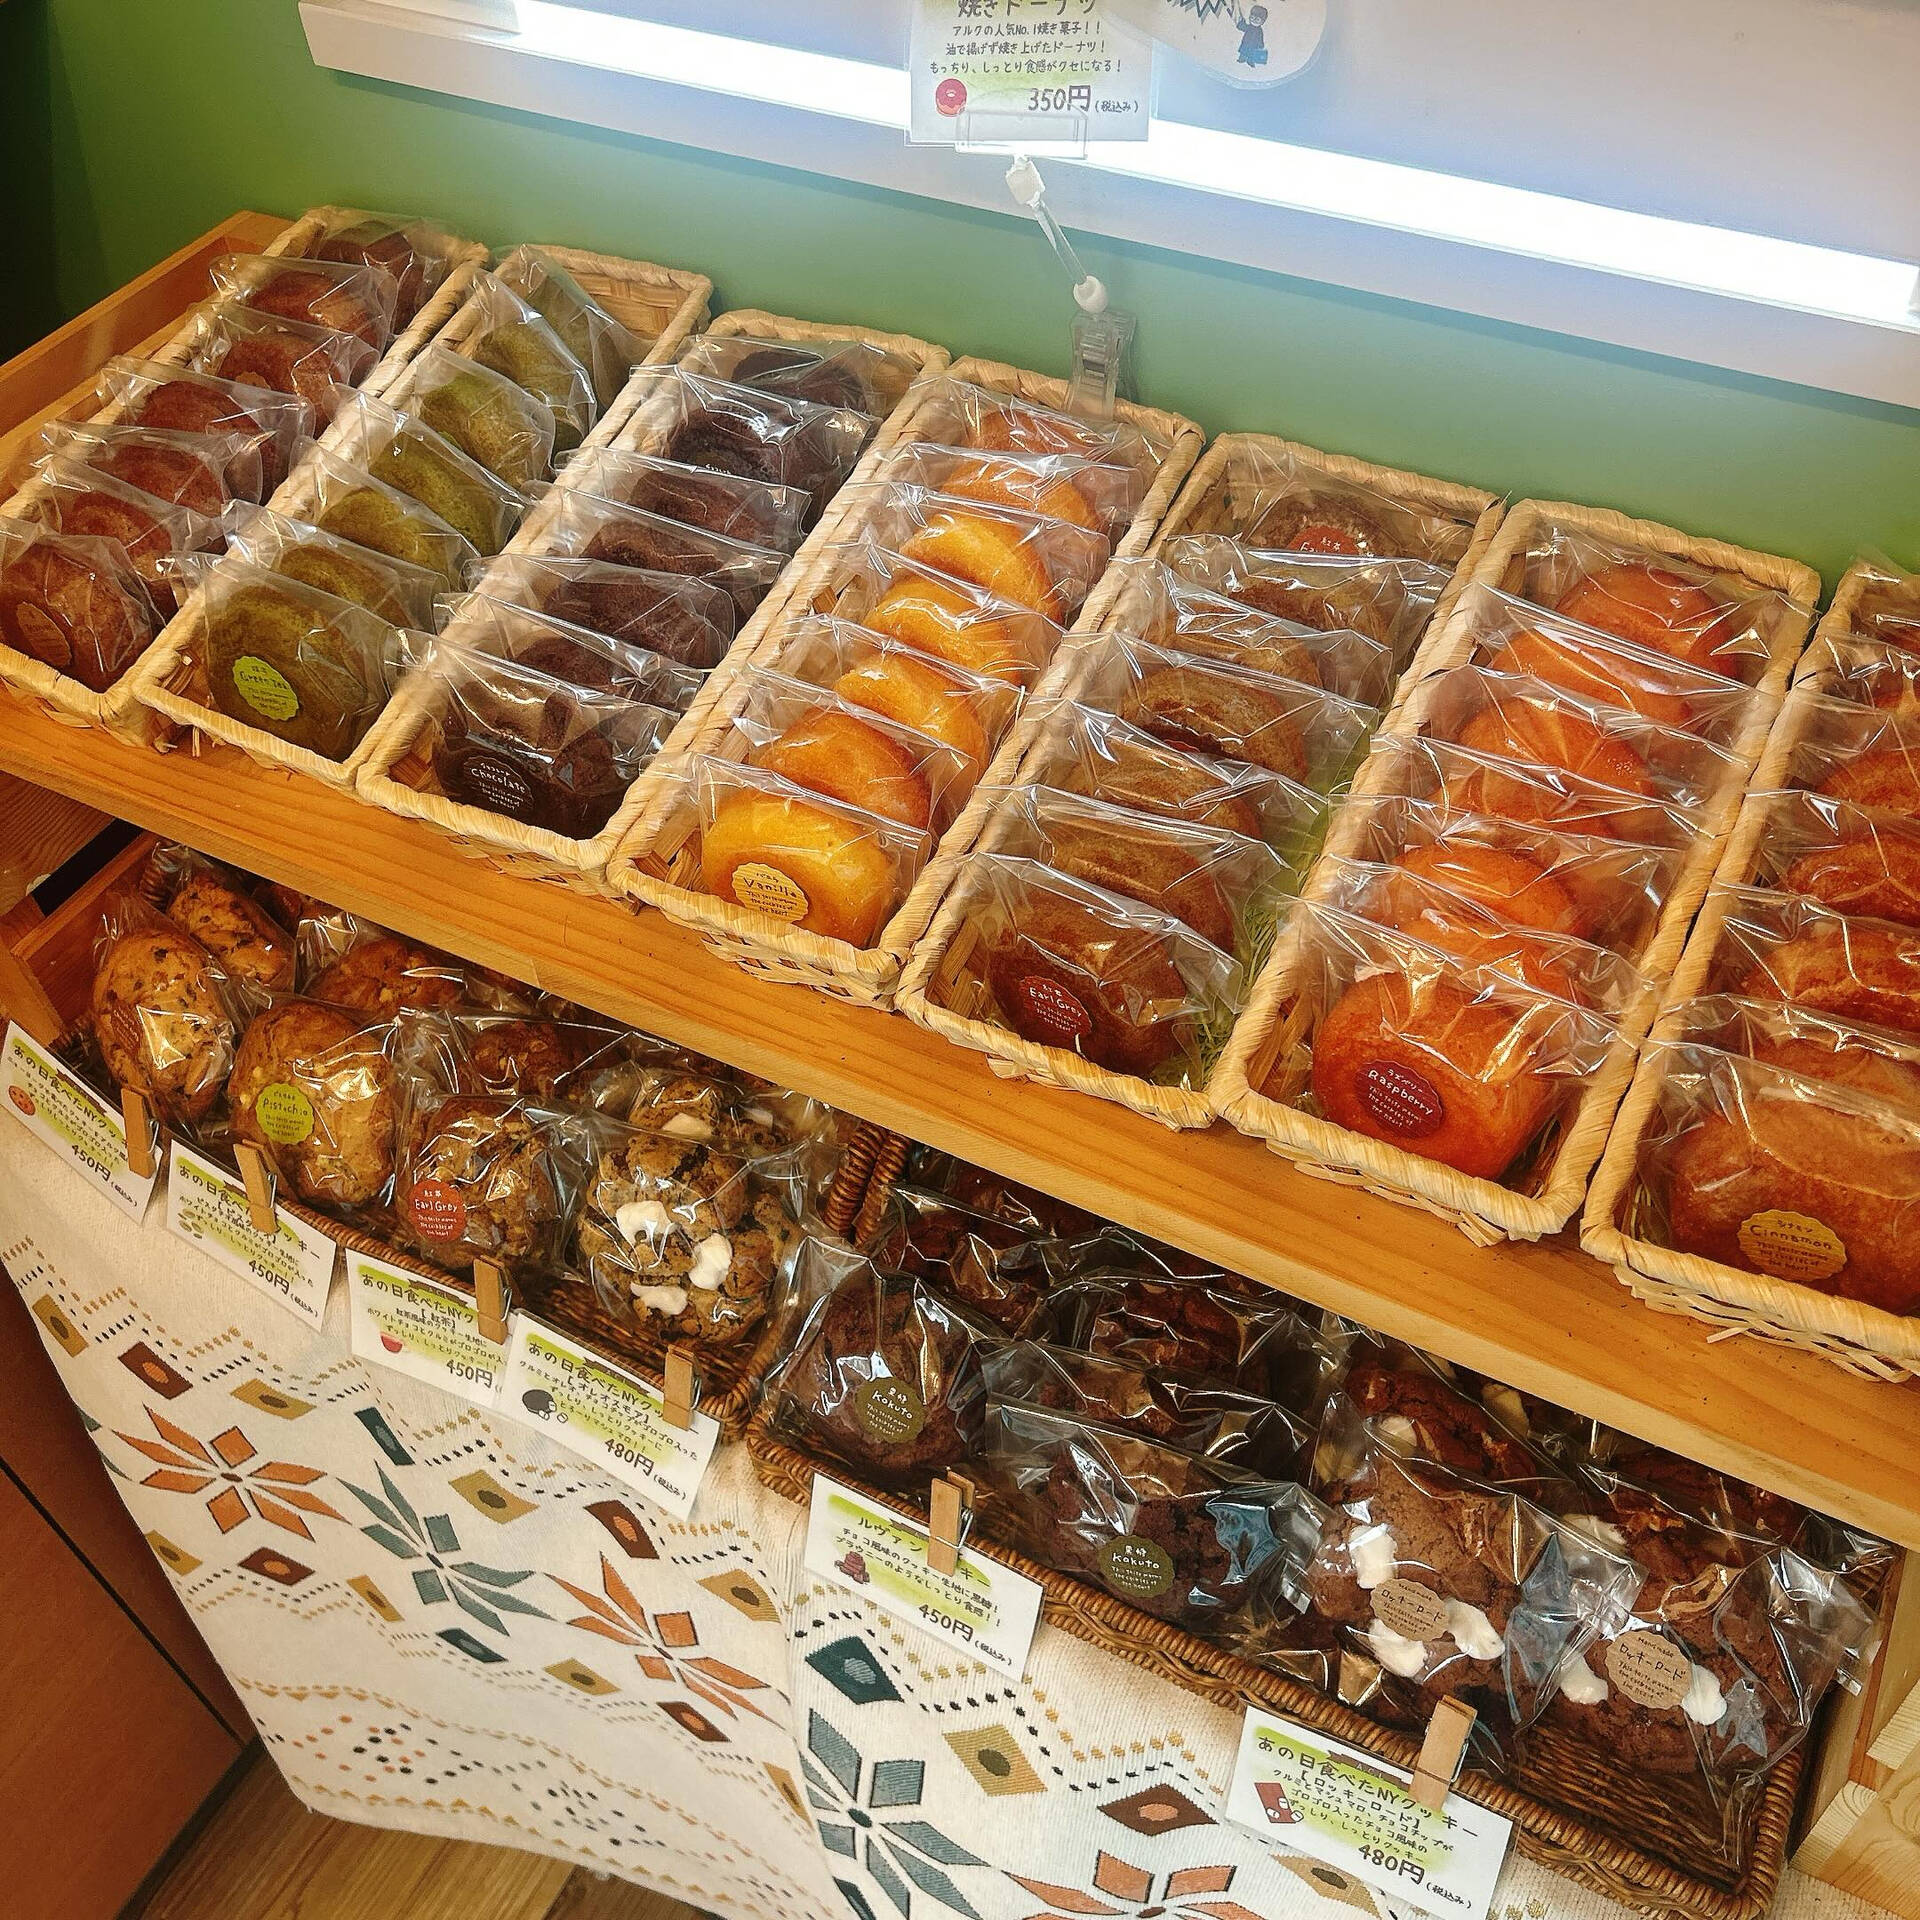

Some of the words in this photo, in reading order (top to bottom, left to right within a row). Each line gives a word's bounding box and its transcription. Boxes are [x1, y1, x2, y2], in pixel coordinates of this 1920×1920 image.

[1027, 85, 1091, 112] 350円
[470, 765, 527, 793] Chocolate
[741, 876, 797, 898] Vanilla
[1027, 985, 1055, 1005] Earl
[1054, 998, 1083, 1017] Grey
[262, 1097, 308, 1117] Pistachio
[1367, 1068, 1433, 1116] Raspberry
[70, 1140, 111, 1182] 450円
[413, 1198, 434, 1211] Earl
[434, 1200, 458, 1213] Grey
[1749, 1223, 1832, 1253] Cinnamon
[248, 1256, 290, 1295] 450円
[445, 1356, 494, 1389] 450円
[871, 1389, 915, 1420] Kokuto
[603, 1435, 654, 1477] 480円
[857, 1514, 992, 1592] ルヴァンキー
[917, 1601, 974, 1643] 450円
[1618, 1640, 1685, 1685] ロッキーロード
[1256, 1733, 1481, 1841] あの日食べたNYクッキー
[1300, 1769, 1421, 1830] 【ロッキーロード】
[1356, 1841, 1426, 1885] 480円
